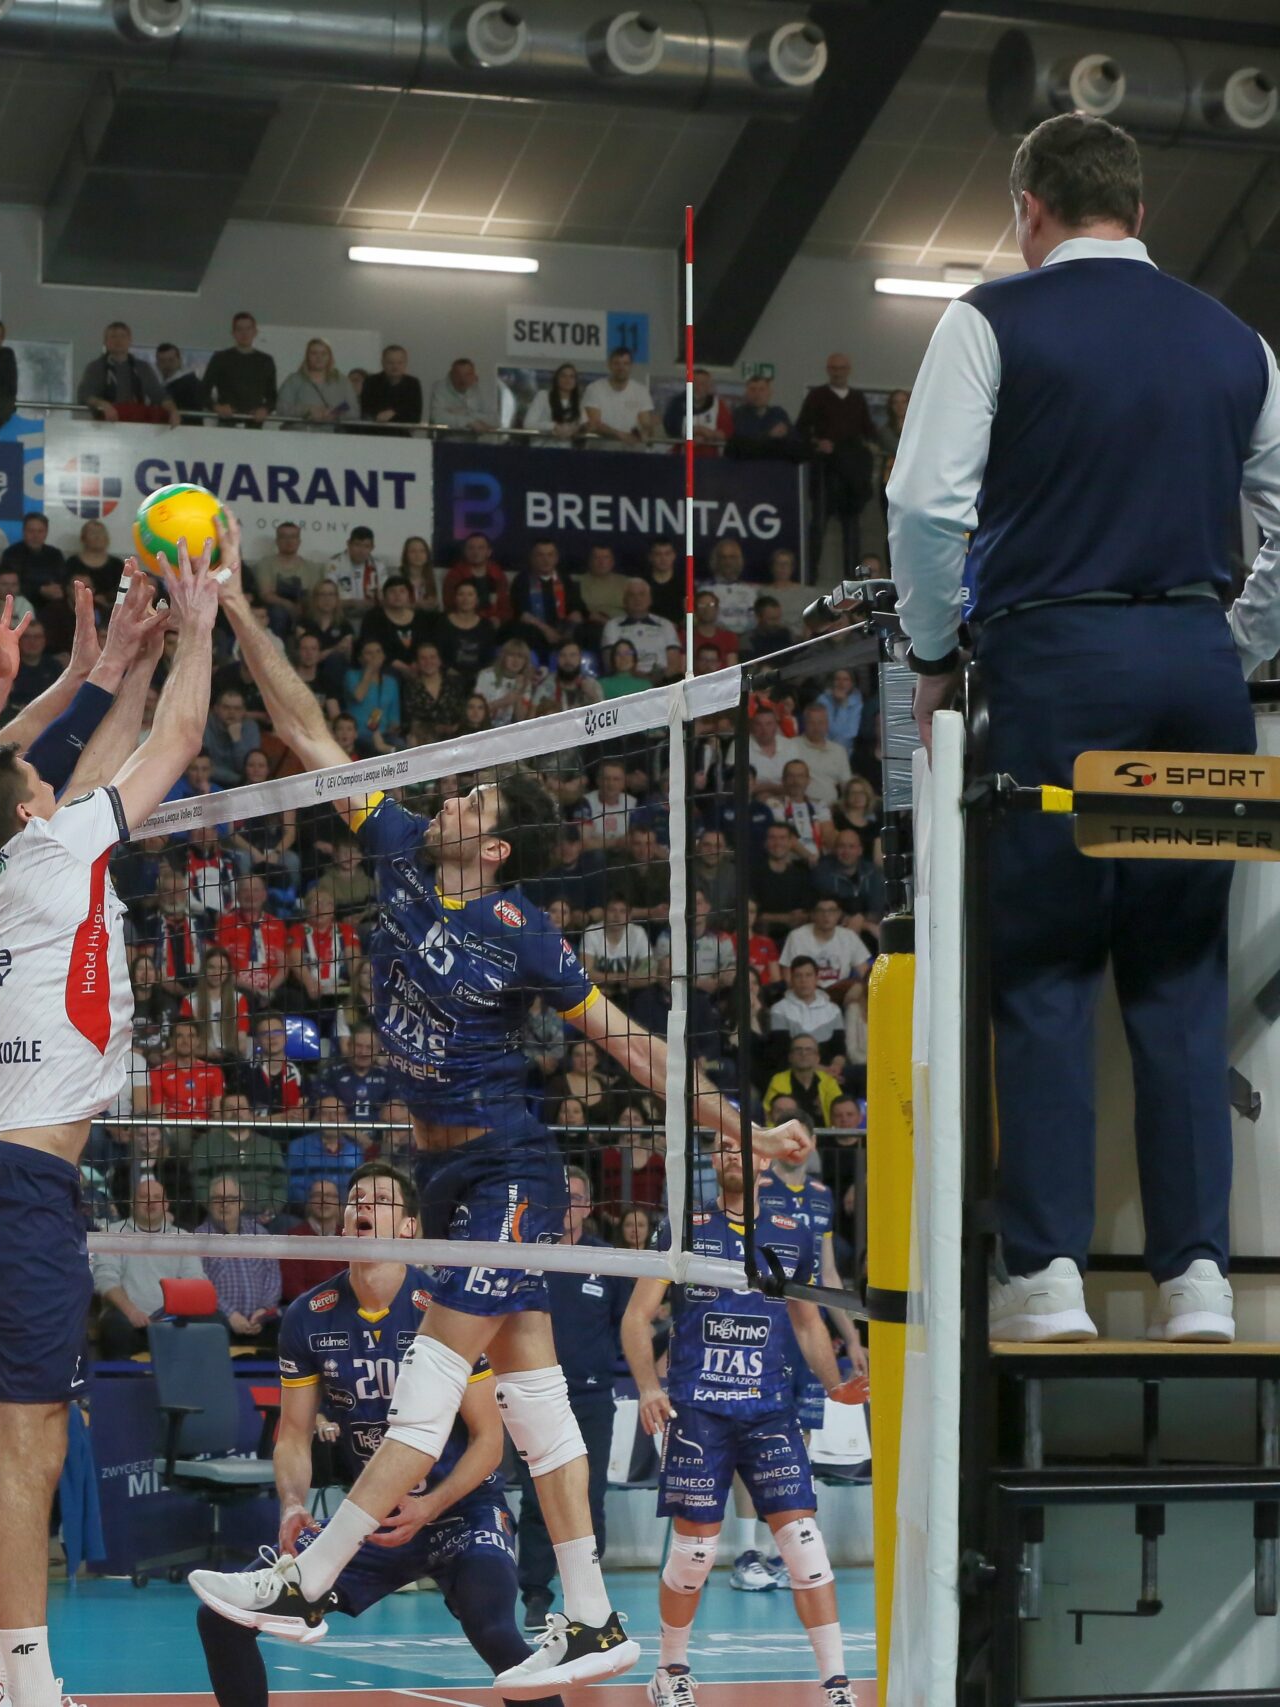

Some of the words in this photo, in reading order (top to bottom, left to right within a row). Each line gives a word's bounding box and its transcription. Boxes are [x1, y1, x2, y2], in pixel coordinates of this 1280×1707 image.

[513, 319, 600, 347] SEKTOR
[526, 491, 781, 539] BRENNTAG
[598, 709, 618, 729] CEV
[337, 771, 362, 787] Champions
[363, 769, 380, 783] League
[381, 763, 396, 779] Volley
[396, 761, 409, 774] 2023
[1166, 768, 1265, 786] SPORT
[1110, 825, 1272, 848] TRANSFER
[464, 1265, 497, 1295] 15
[707, 1320, 768, 1341] TRENTINO
[701, 1347, 763, 1377] ITAS
[353, 1358, 396, 1400] 20
[699, 1372, 762, 1386] ASSICURAZIONI
[763, 1464, 801, 1479] IMECO
[676, 1477, 715, 1488] IMECO
[474, 1530, 506, 1551] 20
[11, 1642, 38, 1655] 4F
